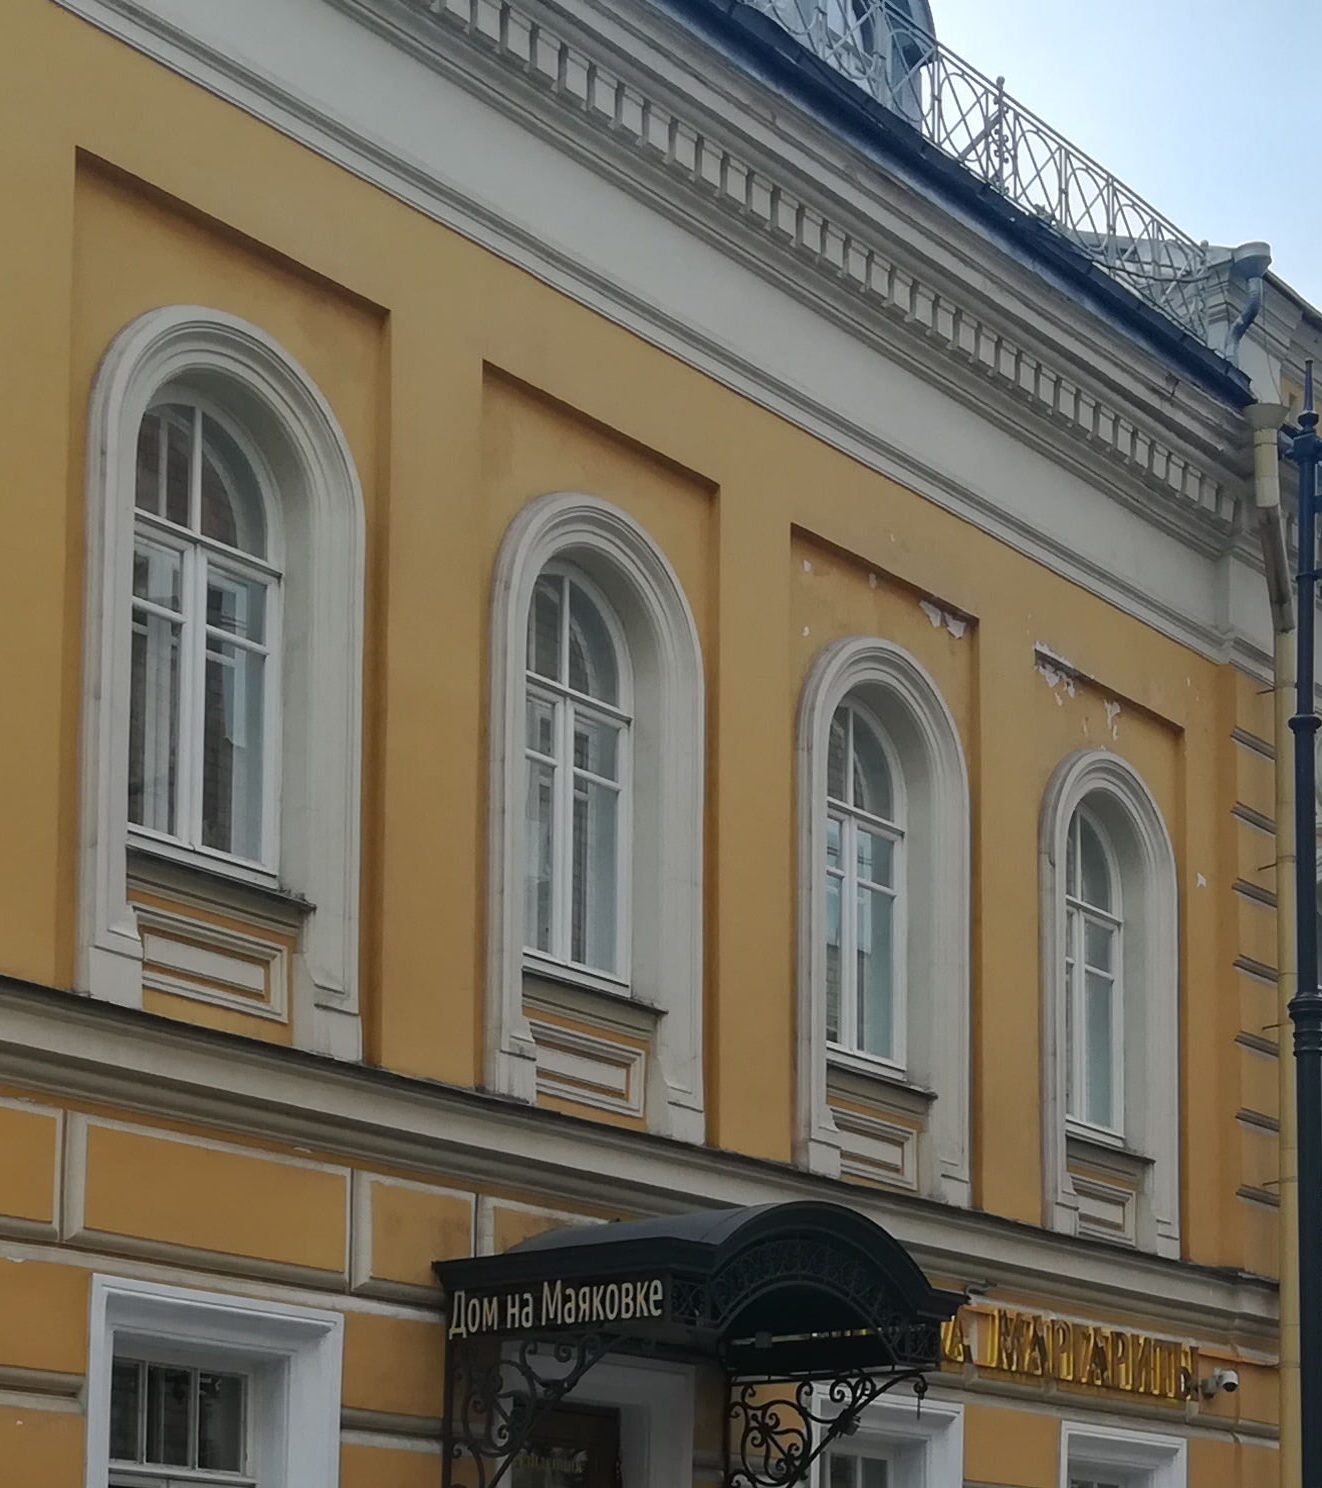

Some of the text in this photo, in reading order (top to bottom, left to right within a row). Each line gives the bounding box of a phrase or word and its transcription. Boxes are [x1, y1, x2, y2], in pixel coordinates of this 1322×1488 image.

[448, 1279, 664, 1340] Дом на Маяковке
